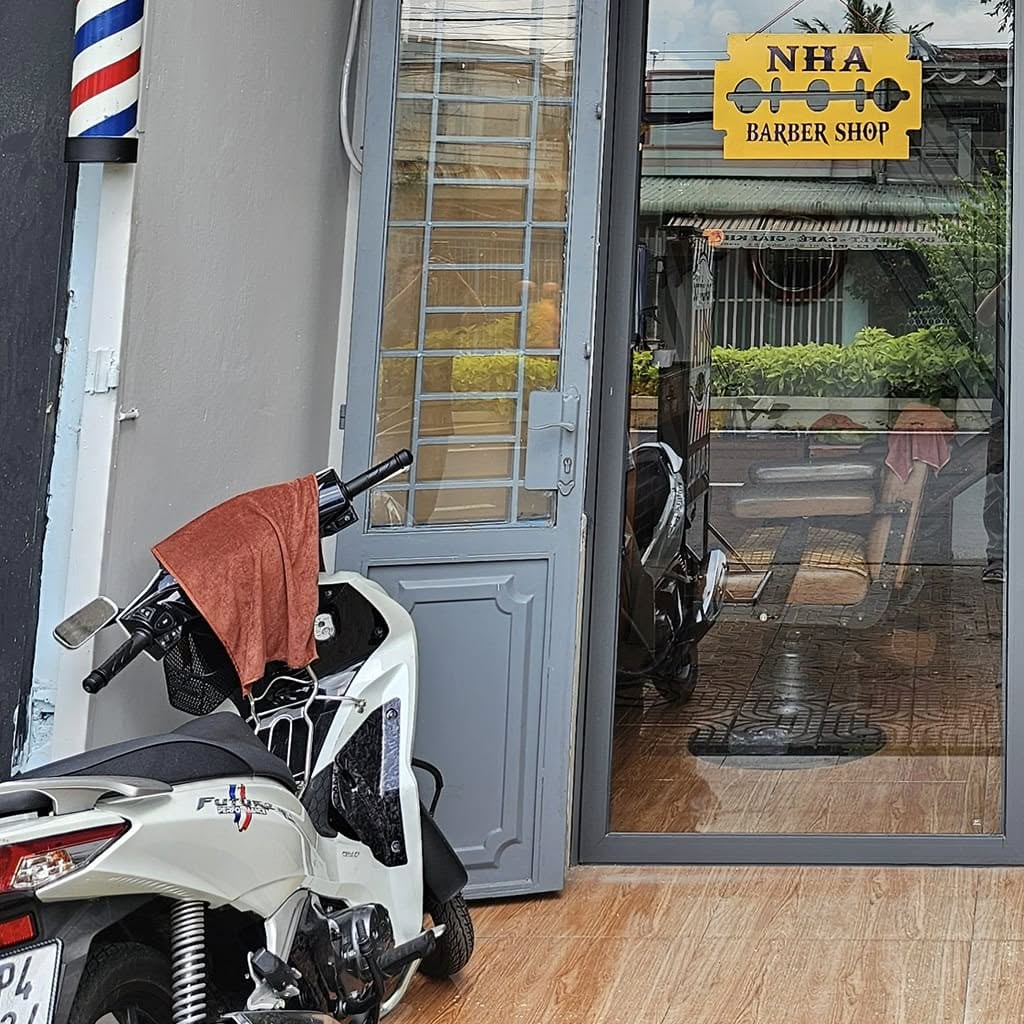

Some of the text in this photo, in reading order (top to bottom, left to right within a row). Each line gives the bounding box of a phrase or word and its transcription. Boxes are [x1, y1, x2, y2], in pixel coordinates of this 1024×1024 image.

[766, 45, 872, 73] NHA
[746, 121, 890, 146] BARBER SHOP
